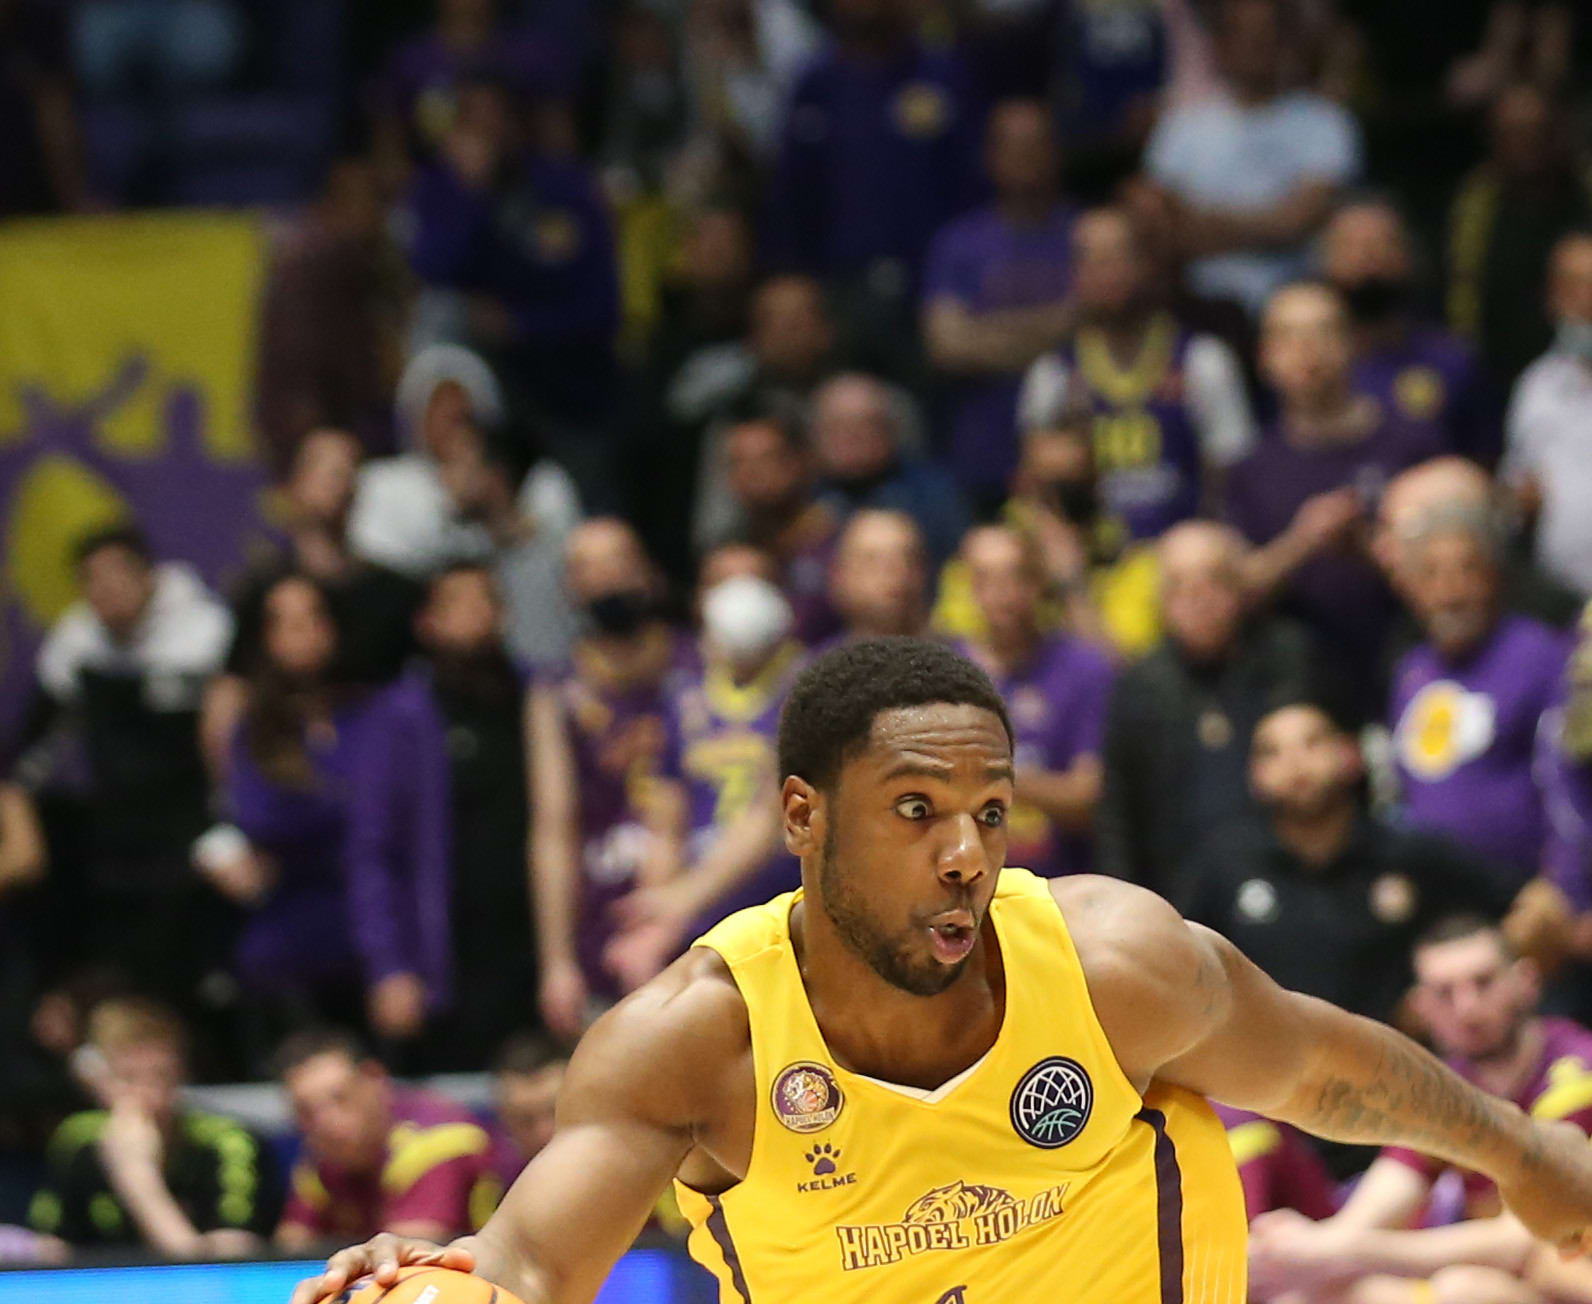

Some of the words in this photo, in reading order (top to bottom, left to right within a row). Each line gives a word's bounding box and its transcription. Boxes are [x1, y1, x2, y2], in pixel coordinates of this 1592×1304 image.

[797, 1172, 857, 1193] KELME
[836, 1220, 969, 1271] HAPOEL
[974, 1181, 1072, 1246] HOLON
